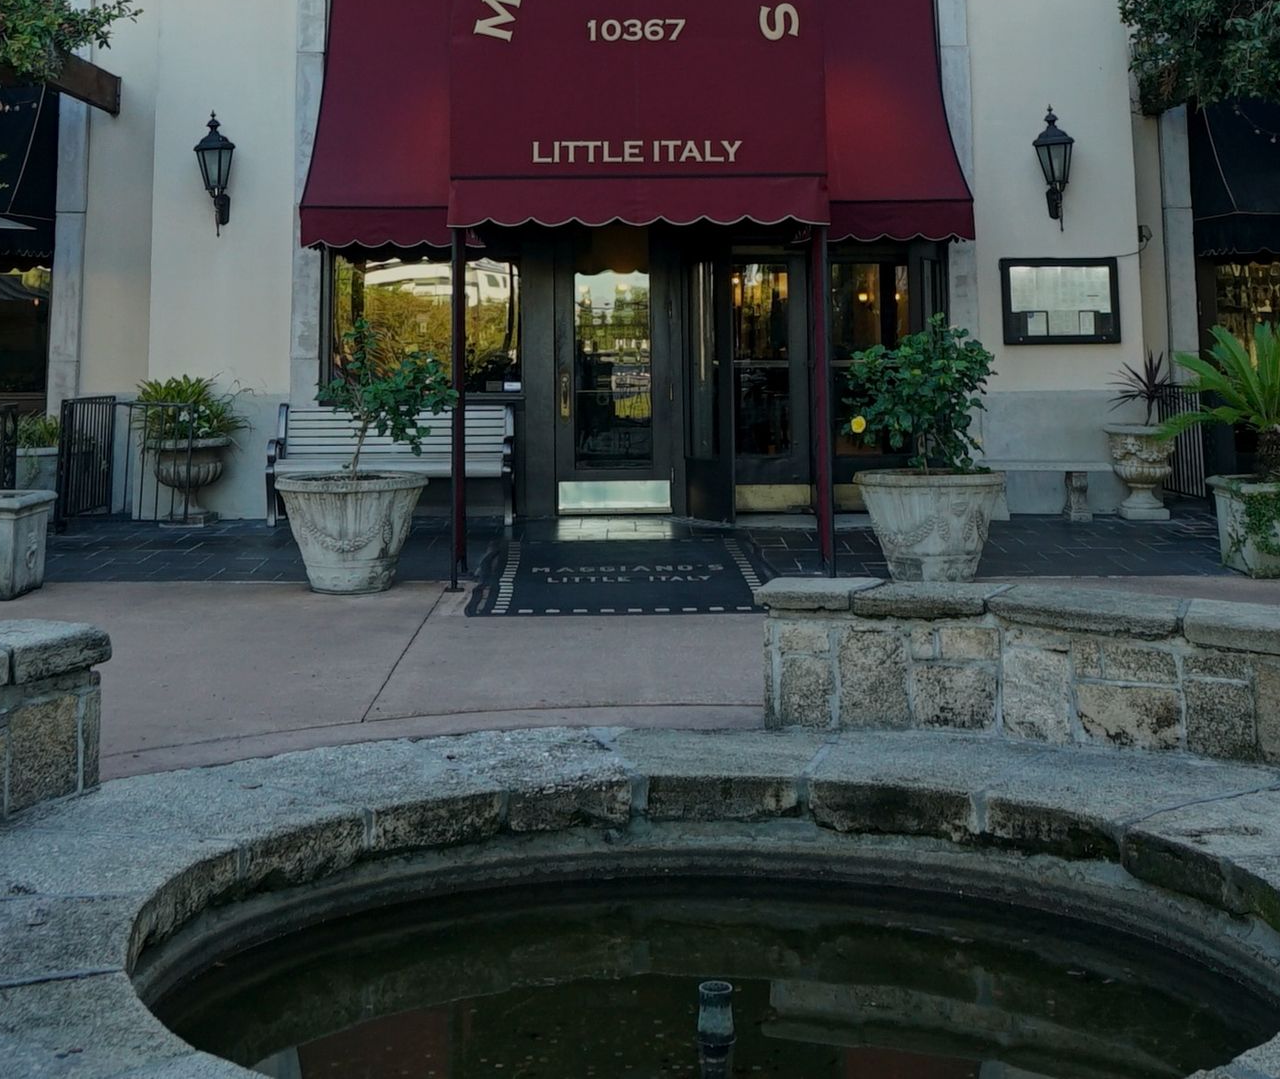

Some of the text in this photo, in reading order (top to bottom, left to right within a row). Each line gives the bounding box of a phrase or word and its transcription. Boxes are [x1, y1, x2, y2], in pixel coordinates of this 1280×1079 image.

[587, 18, 686, 42] 10367
[531, 139, 743, 163] LITTLE ITALY
[531, 563, 724, 573] MAGGIANO'S
